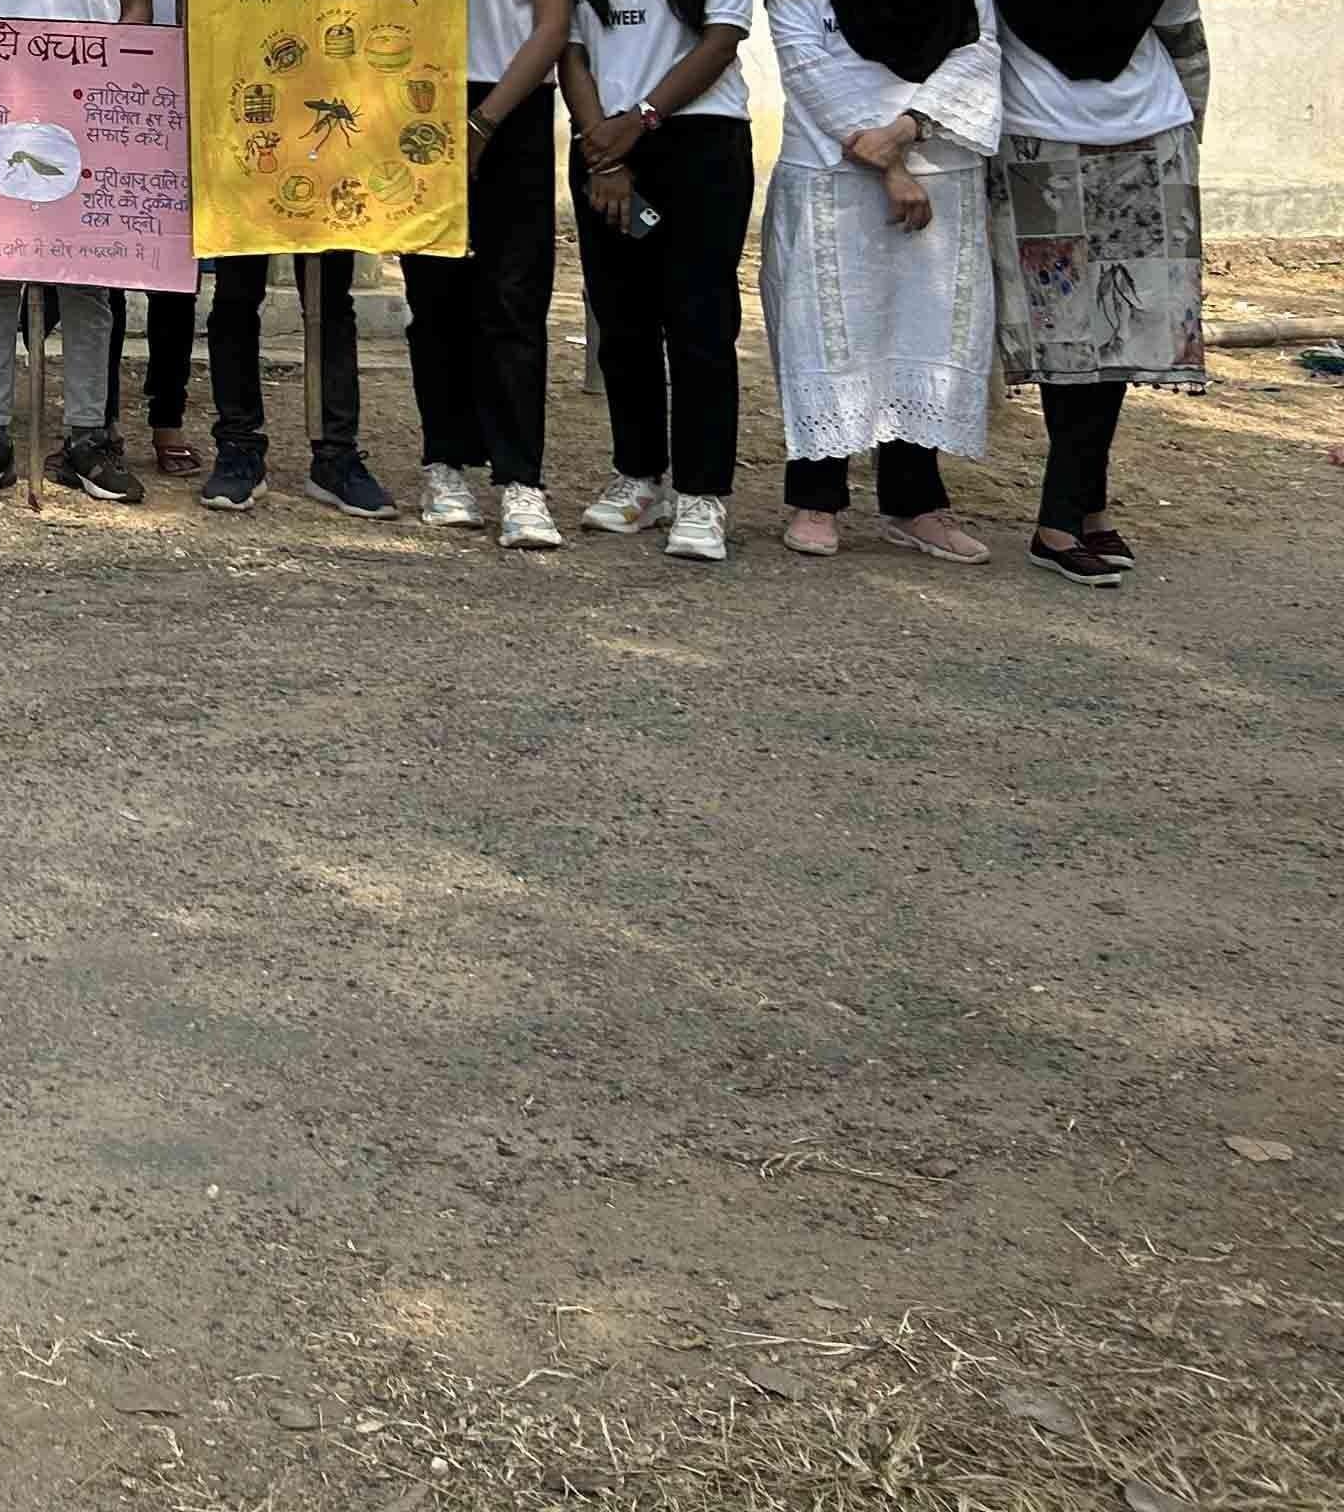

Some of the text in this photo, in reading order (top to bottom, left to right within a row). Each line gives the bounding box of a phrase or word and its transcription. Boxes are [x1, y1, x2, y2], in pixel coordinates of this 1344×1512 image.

[611, 10, 647, 26] WEEK
[27, 33, 110, 67] बचाव
[152, 85, 181, 109] की
[94, 166, 120, 193] पूरी
[117, 189, 140, 210] को
